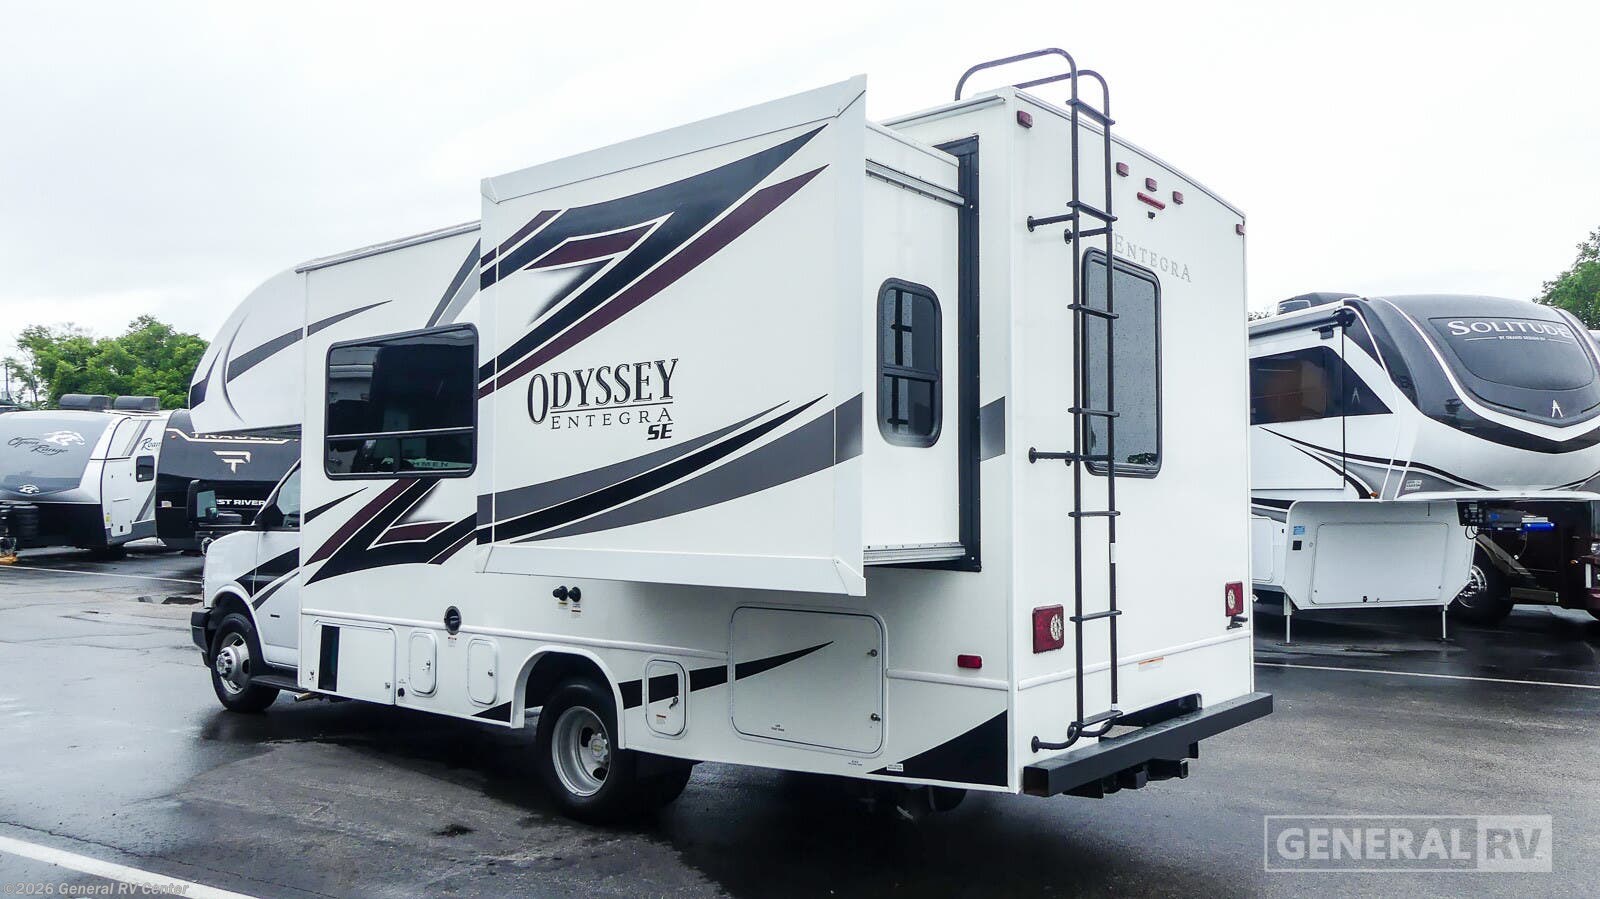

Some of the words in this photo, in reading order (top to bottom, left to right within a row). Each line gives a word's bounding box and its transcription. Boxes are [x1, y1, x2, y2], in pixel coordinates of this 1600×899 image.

[1114, 232, 1192, 282] ENTEGRA
[1448, 320, 1574, 339] SOLITUDE
[527, 357, 679, 425] ODYSSEY
[551, 407, 673, 430] ENTEGRA
[647, 422, 673, 441] SE
[7, 436, 40, 448] Open
[31, 444, 69, 456] Range
[233, 498, 266, 506] RIVER
